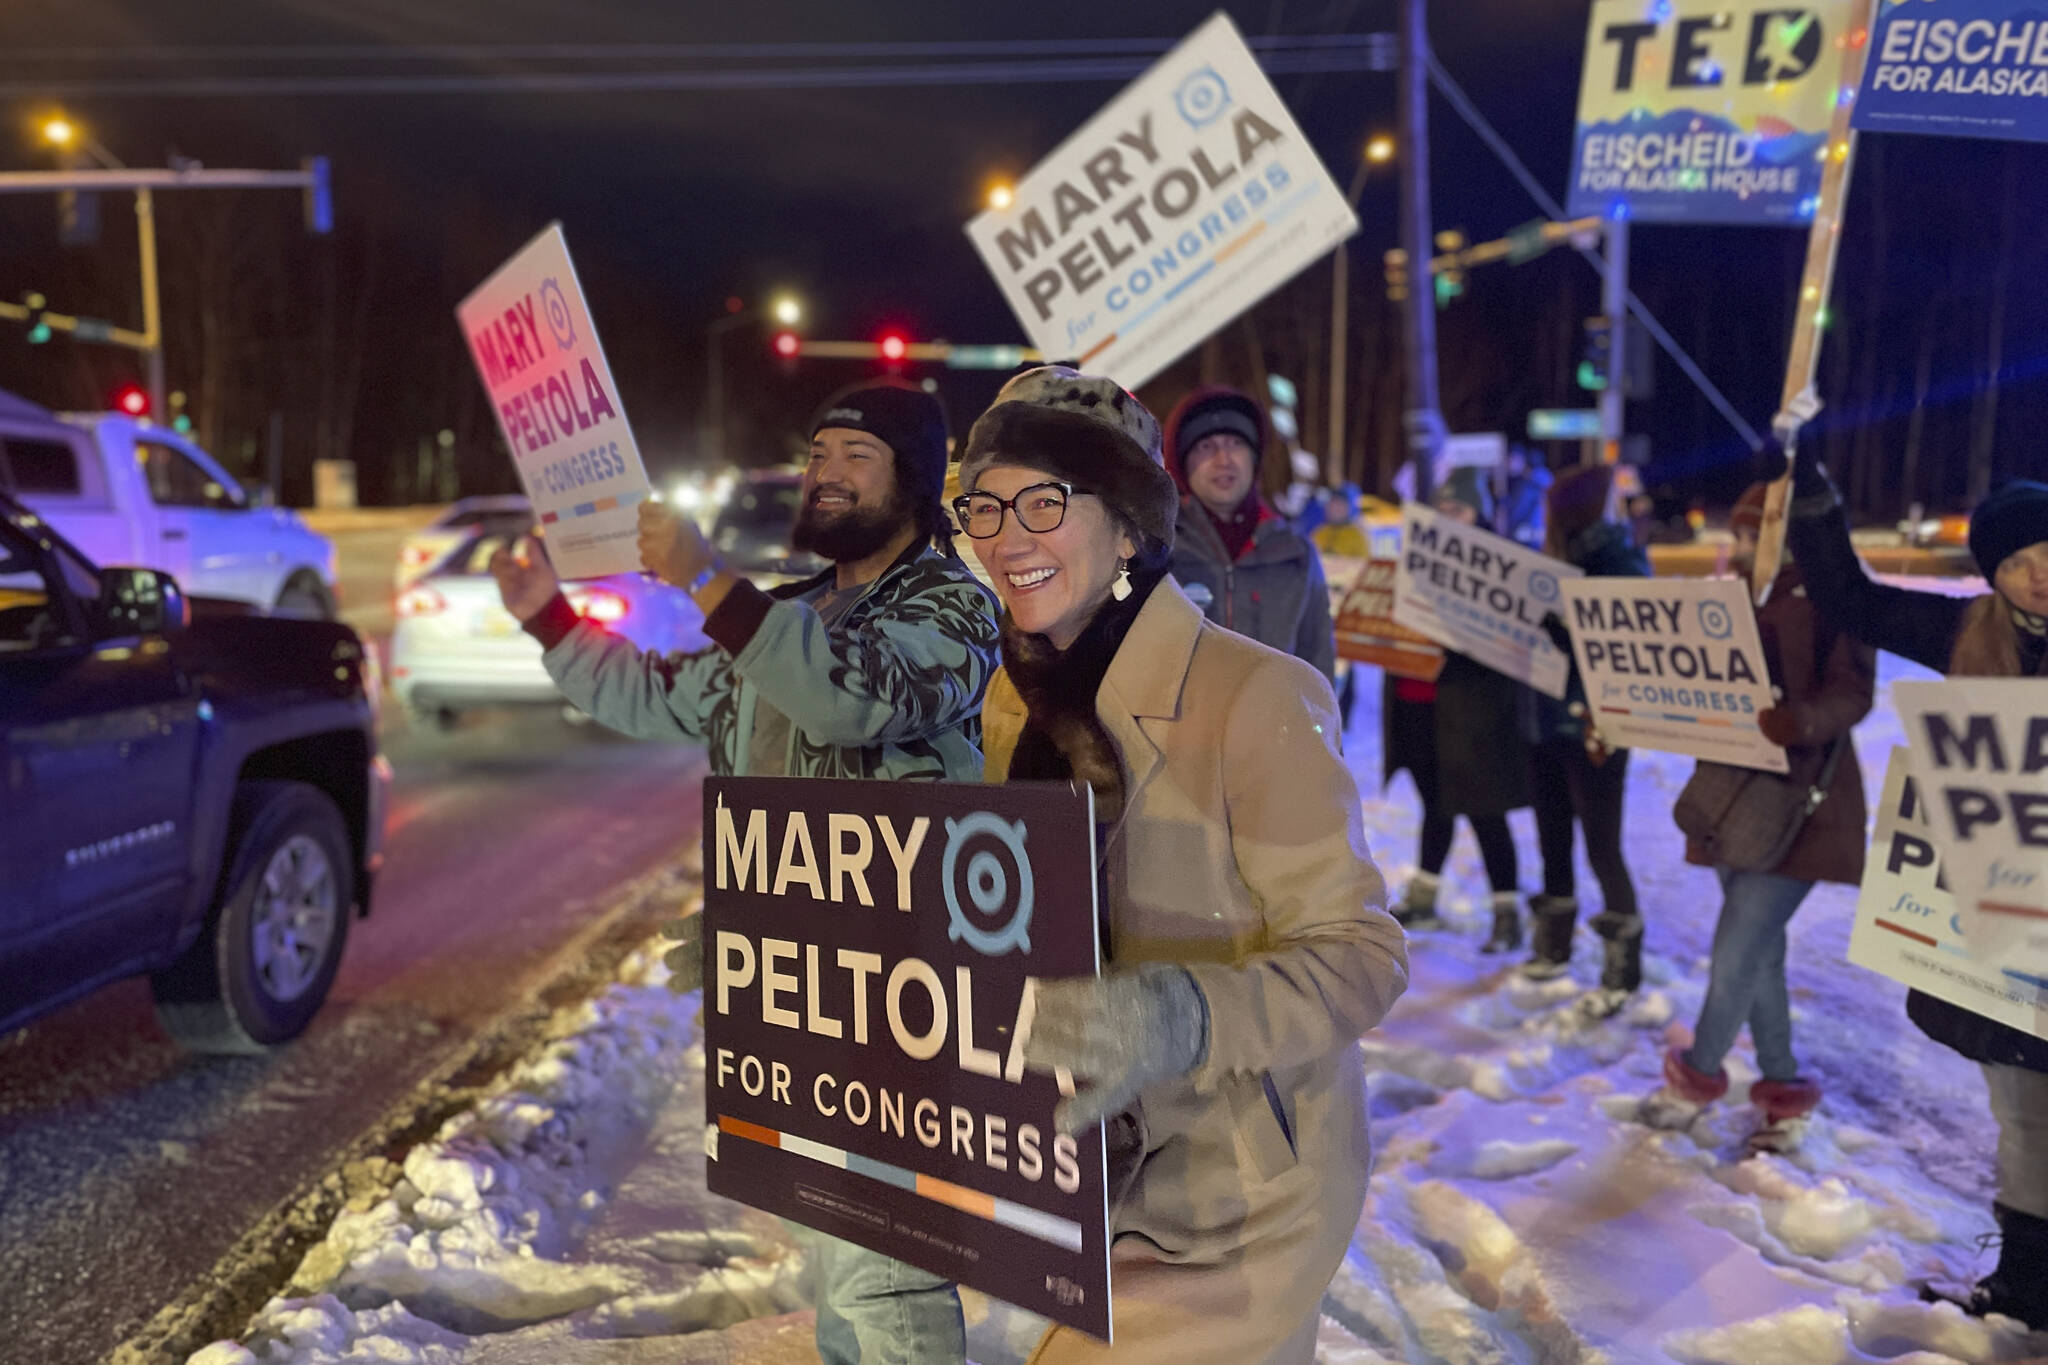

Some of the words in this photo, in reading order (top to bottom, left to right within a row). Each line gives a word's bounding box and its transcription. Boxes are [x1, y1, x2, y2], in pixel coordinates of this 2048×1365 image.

[1604, 9, 1823, 92] TED
[1872, 64, 1933, 92] FOR
[1932, 66, 2048, 97] ALASKA
[1578, 168, 1621, 192] FOR
[1624, 168, 1708, 192] ALASKA
[1711, 167, 1799, 193] HOUSE
[1583, 131, 1758, 170] EISCHEID
[995, 111, 1160, 273] MARY
[1022, 106, 1285, 322] PELTOLA
[1065, 311, 1098, 348] for
[1105, 161, 1291, 313] CONGRESS
[475, 293, 546, 387] MARY
[501, 357, 616, 457] PELTOLA
[543, 441, 626, 494] CONGRESS
[1410, 519, 1518, 580] MARY
[1407, 551, 1547, 627] PELTOL
[1573, 597, 1682, 634] MARY
[1584, 638, 1758, 684] PELTOLA
[1627, 684, 1754, 714] CONGRESS
[714, 806, 931, 912] MARY
[1889, 892, 1938, 918] for
[716, 1048, 793, 1105] FOR
[813, 1073, 1082, 1194] CONGRESS
